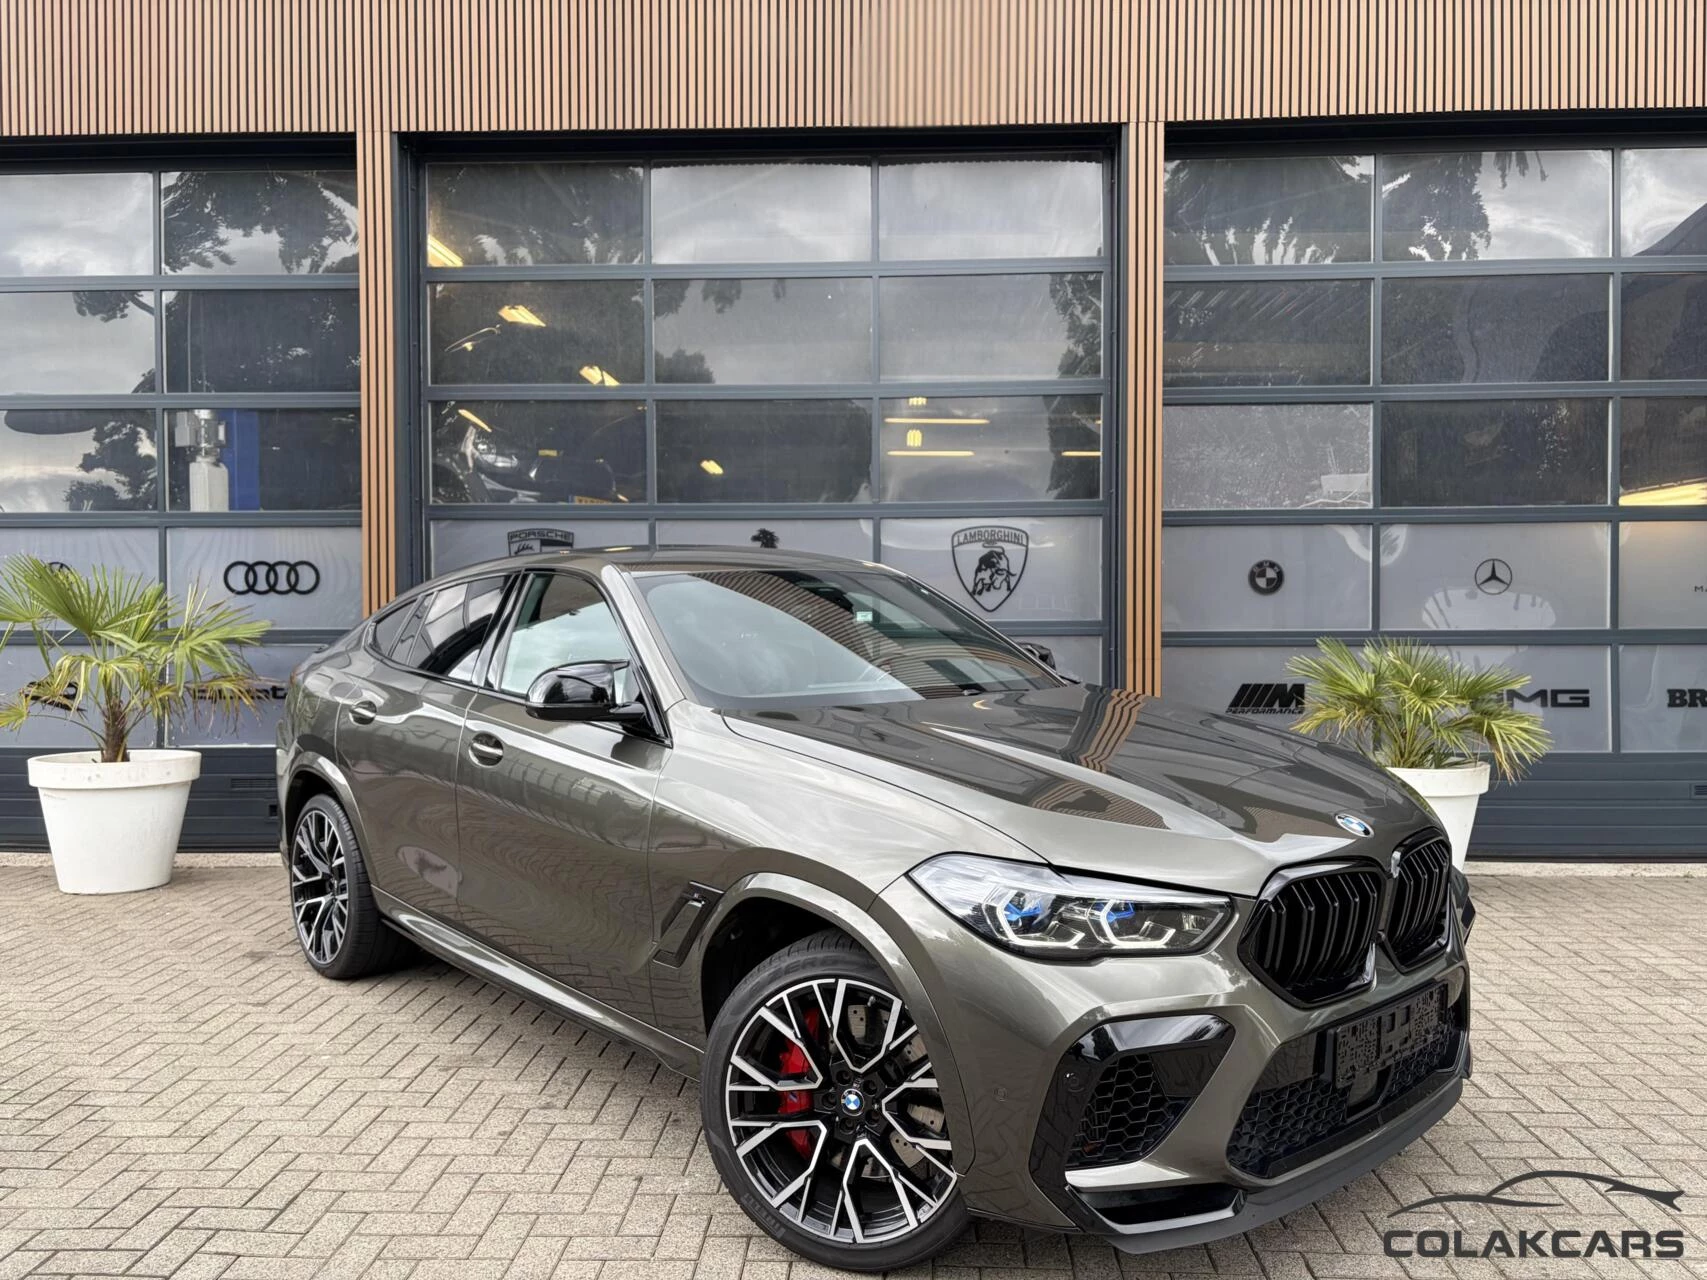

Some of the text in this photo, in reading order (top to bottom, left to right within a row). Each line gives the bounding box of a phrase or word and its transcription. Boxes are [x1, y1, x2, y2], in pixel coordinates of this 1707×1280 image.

[509, 529, 571, 540] PORSCHE
[957, 529, 1024, 545] LAMBORGHINI
[1497, 689, 1590, 708] MG
